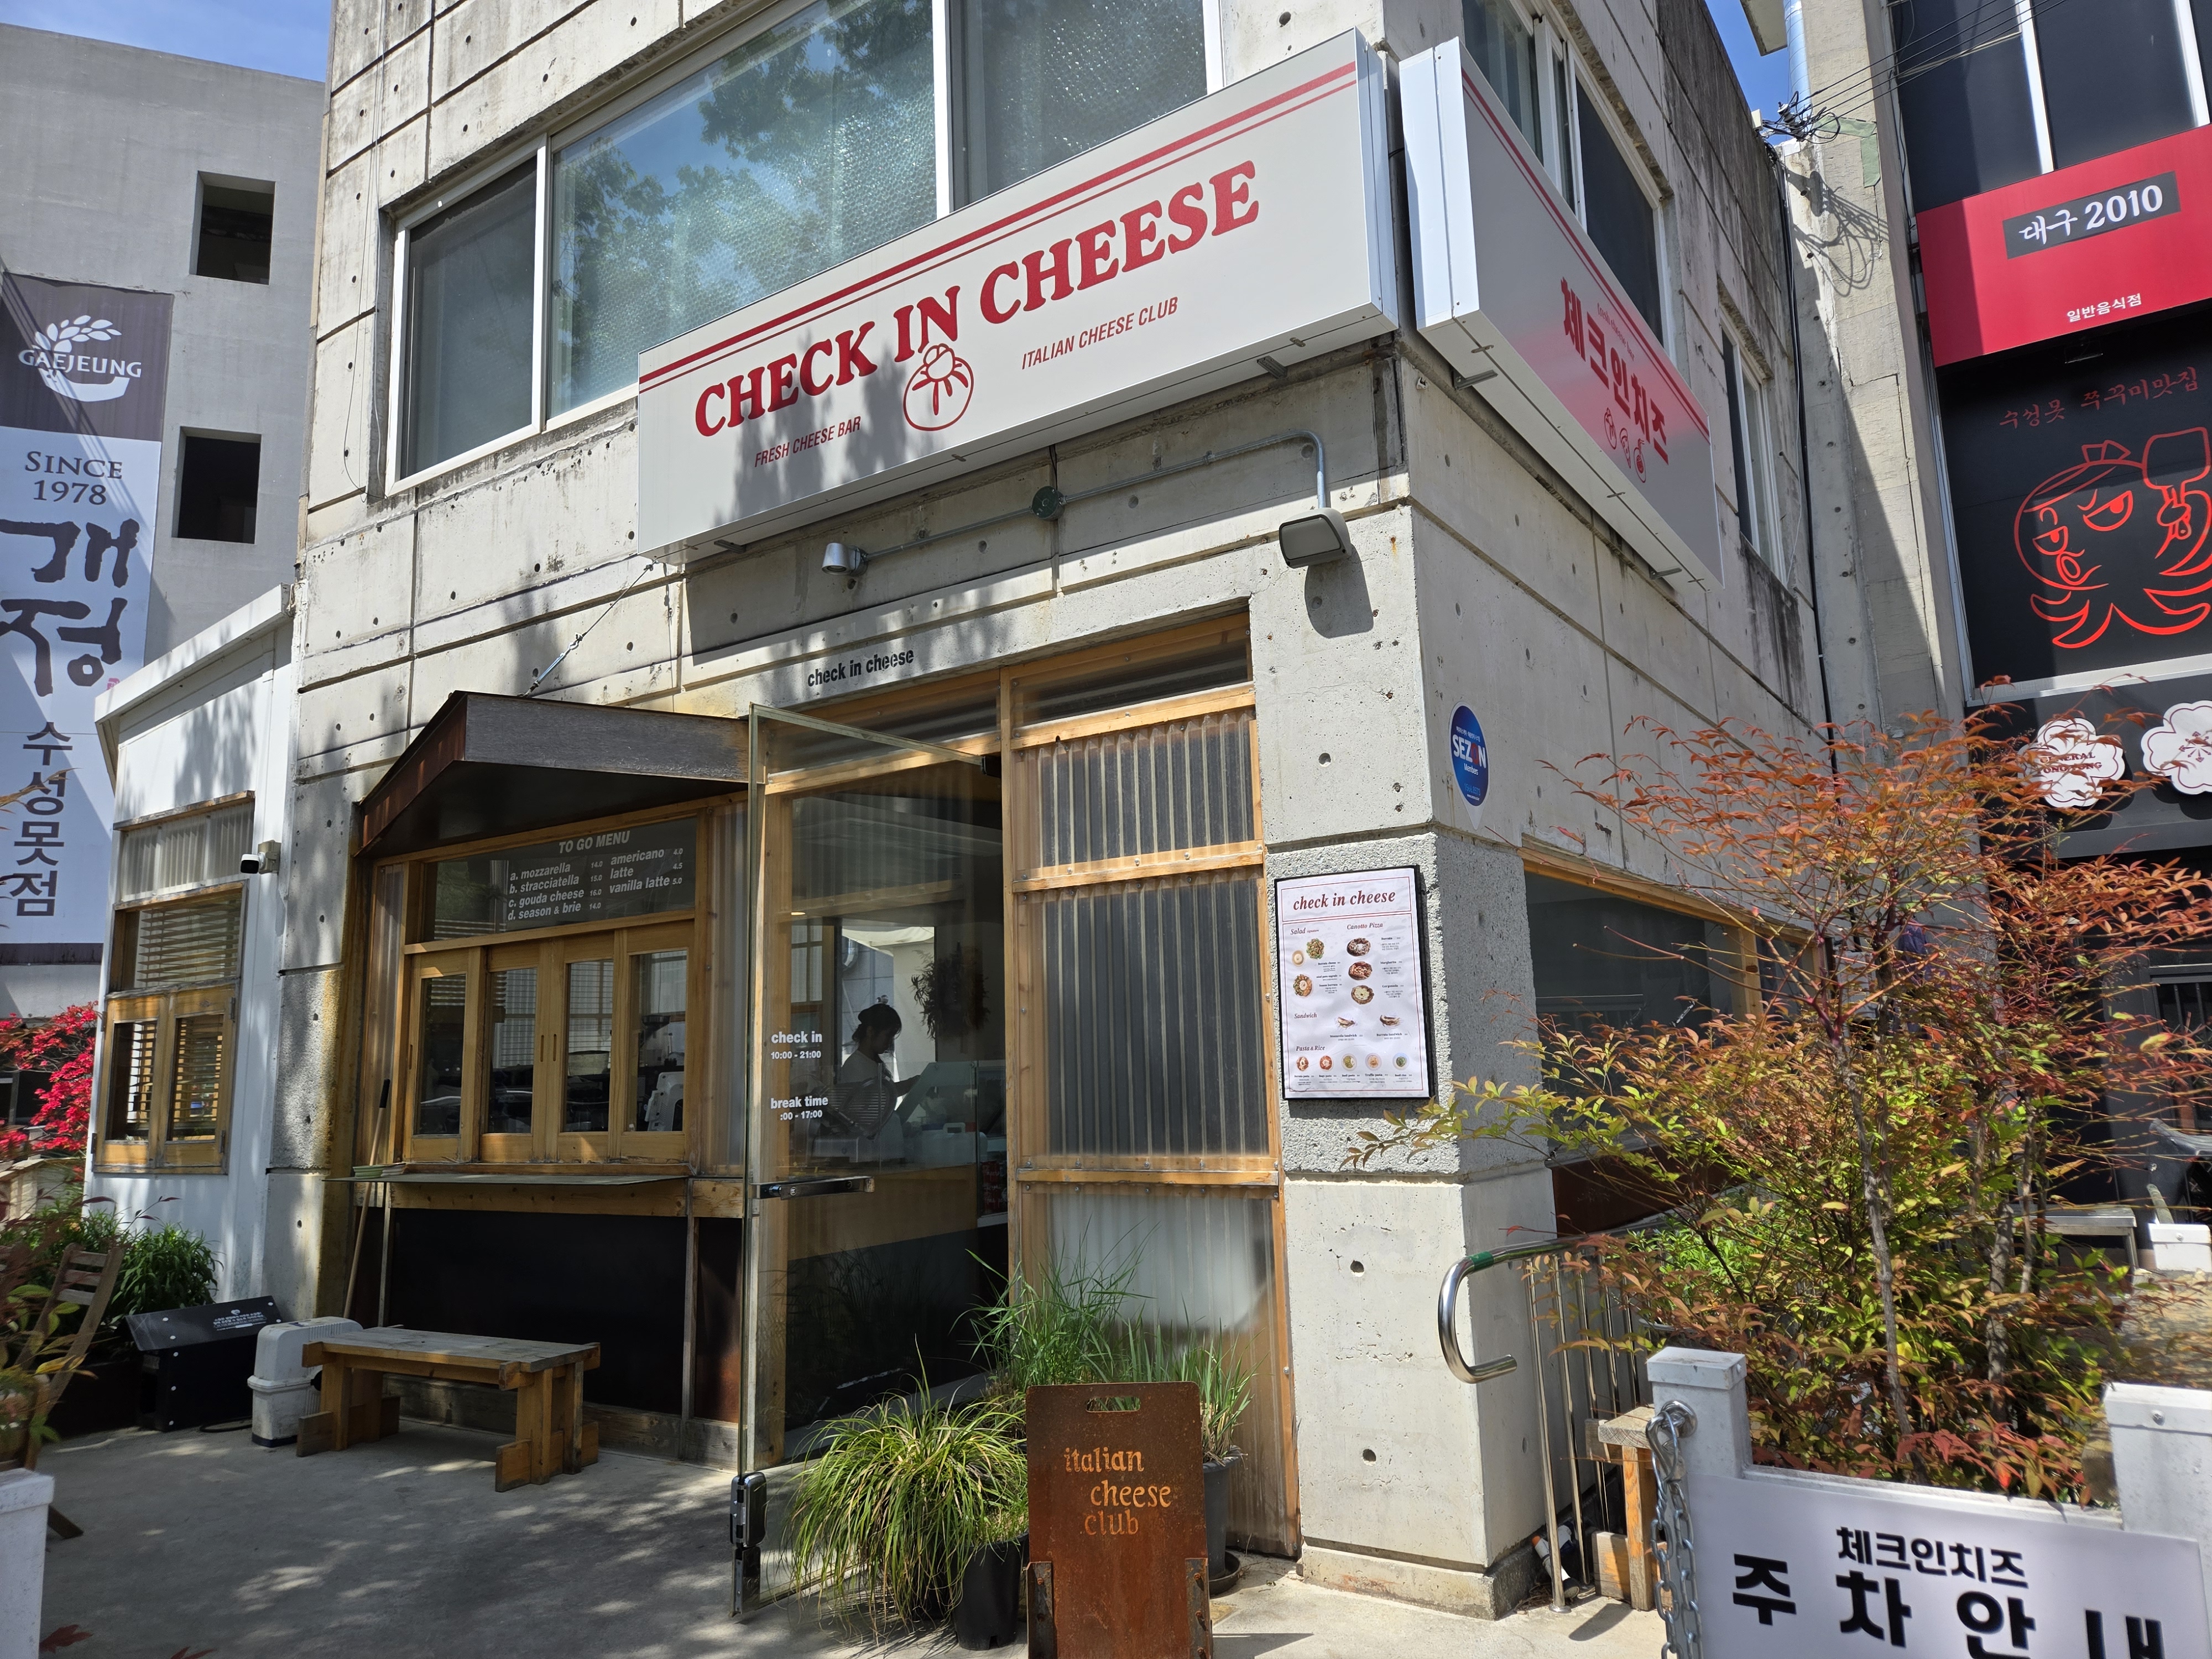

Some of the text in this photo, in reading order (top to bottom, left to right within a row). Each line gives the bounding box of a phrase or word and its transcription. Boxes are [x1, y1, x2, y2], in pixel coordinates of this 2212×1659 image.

[2019, 185, 2163, 245] 대구 2010
[695, 160, 1259, 437] CHECK IN CHEESE
[2066, 293, 2142, 323] 일반음식점
[1022, 296, 1178, 370] ITALIAN CHEESE CLUB
[18, 349, 142, 378] GAEJEUNG
[1561, 276, 1669, 466] 체크인치즈
[754, 416, 861, 467] FRESH CHEESE BAR
[25, 451, 123, 479] SINCE
[33, 479, 107, 505] 1978
[0, 518, 140, 697] 개정
[807, 649, 914, 687] check in cheese
[1452, 734, 1486, 769] SEZON
[1464, 763, 1479, 775] Members
[2037, 765, 2067, 774] ONG
[9, 721, 73, 916] 수성못점
[559, 830, 630, 854] TO GO MENU
[611, 849, 665, 865] americano
[510, 860, 603, 881] a. mozzarella 14.0
[610, 867, 634, 879] latte
[509, 884, 517, 894] b.
[520, 874, 579, 893] stracciatella
[609, 879, 642, 894] vanilla
[645, 875, 670, 889] latte
[508, 899, 517, 907] c.
[519, 893, 547, 908] gouda
[550, 889, 585, 902] cheese
[508, 910, 515, 921] d.
[518, 906, 551, 919] season
[554, 906, 560, 914] &
[562, 901, 581, 914] brie
[1293, 890, 1396, 910] check in cheese
[771, 1030, 823, 1044] check in
[771, 1051, 792, 1060] 10:00
[800, 1050, 822, 1059] 21:00
[770, 1095, 828, 1109] break time
[801, 1109, 823, 1119] 17:00
[1064, 1447, 1144, 1472] italian
[1091, 1480, 1171, 1508] cheese
[1084, 1509, 1139, 1536] club
[1836, 1526, 2030, 1589] 체크인치즈
